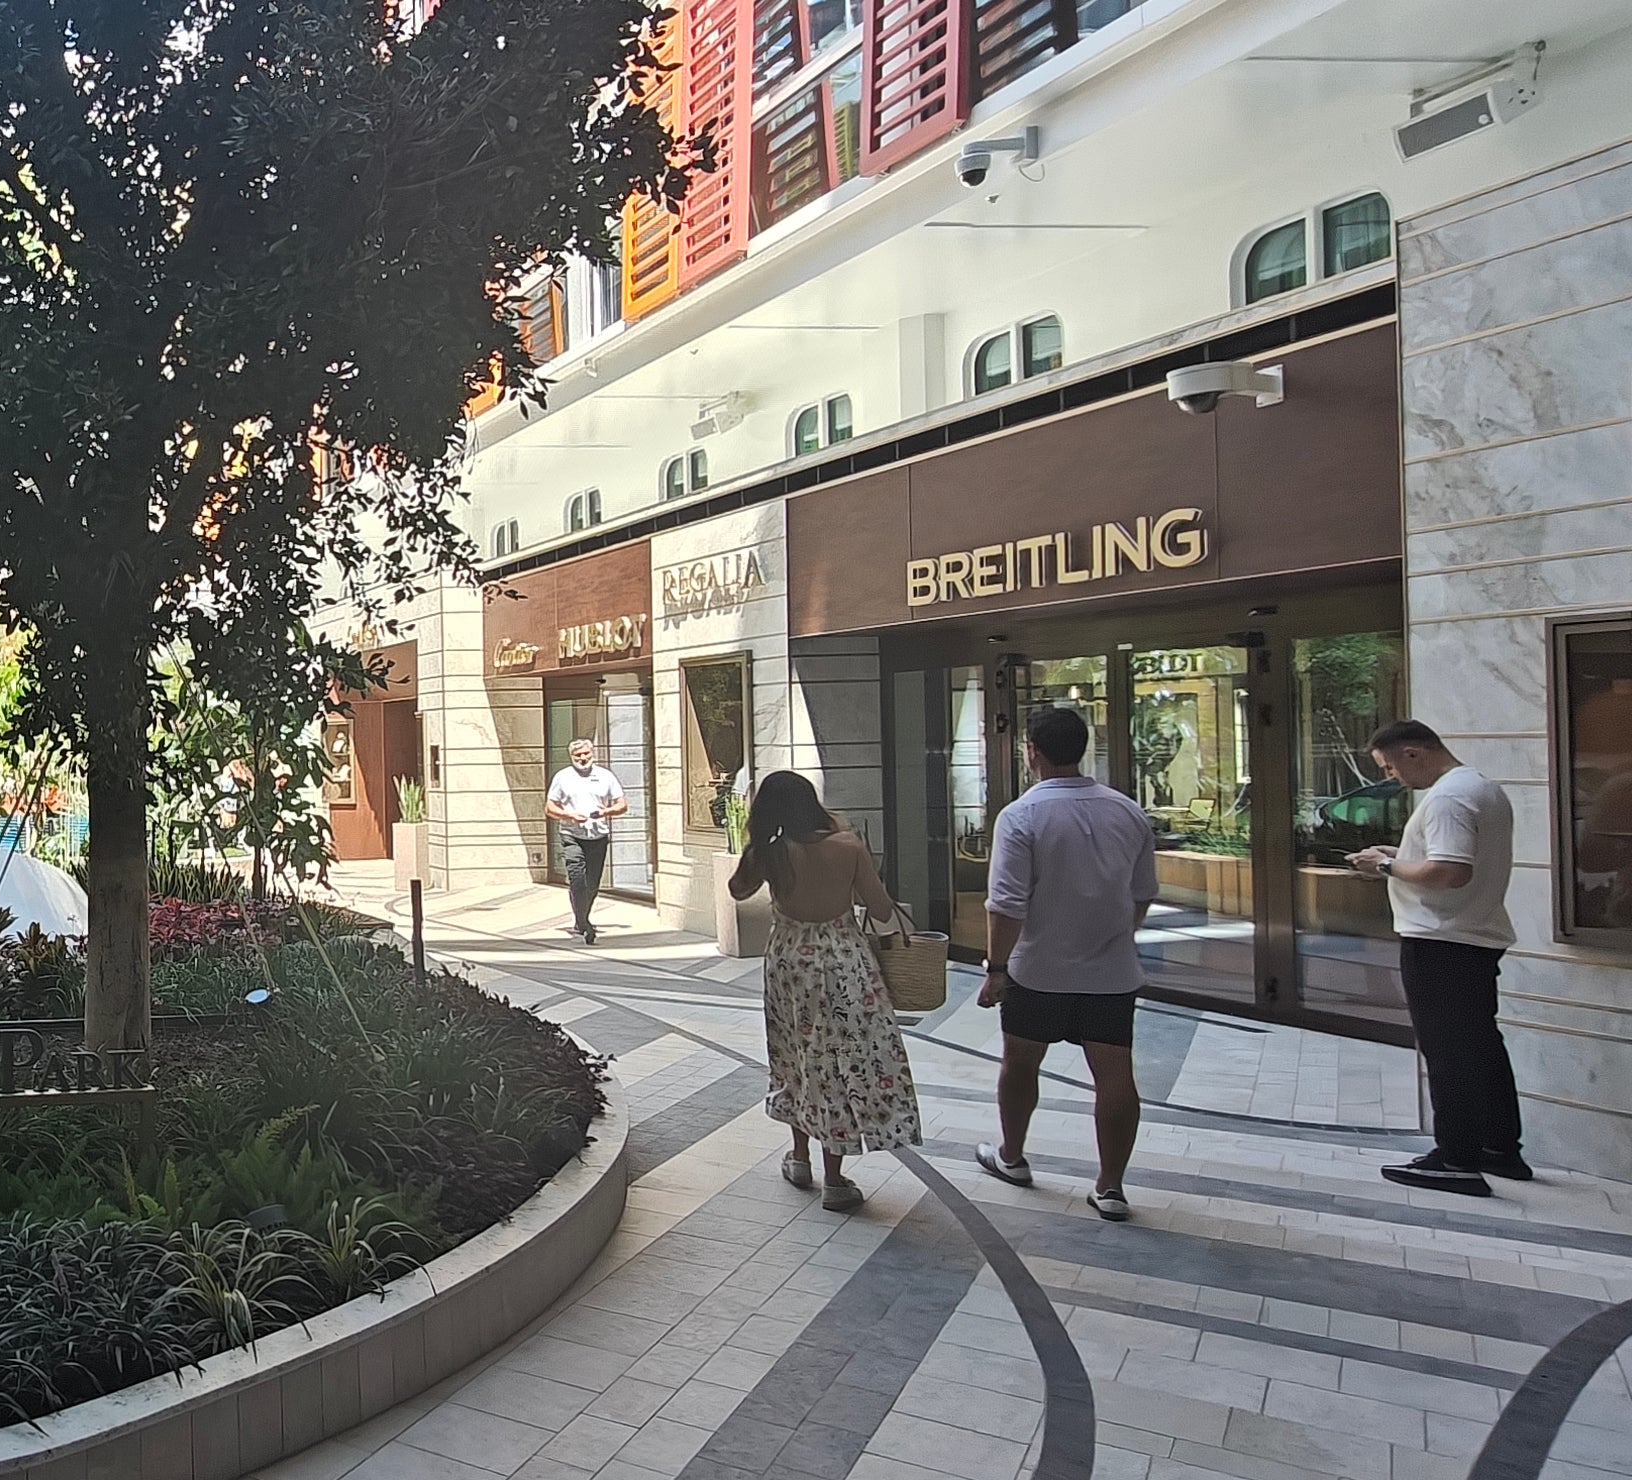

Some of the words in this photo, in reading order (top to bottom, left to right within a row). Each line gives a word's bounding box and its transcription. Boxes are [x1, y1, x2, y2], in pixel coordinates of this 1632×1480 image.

[662, 550, 766, 605] REGALIA
[906, 507, 1209, 607] BREITLING
[557, 613, 648, 660] HUBLOT
